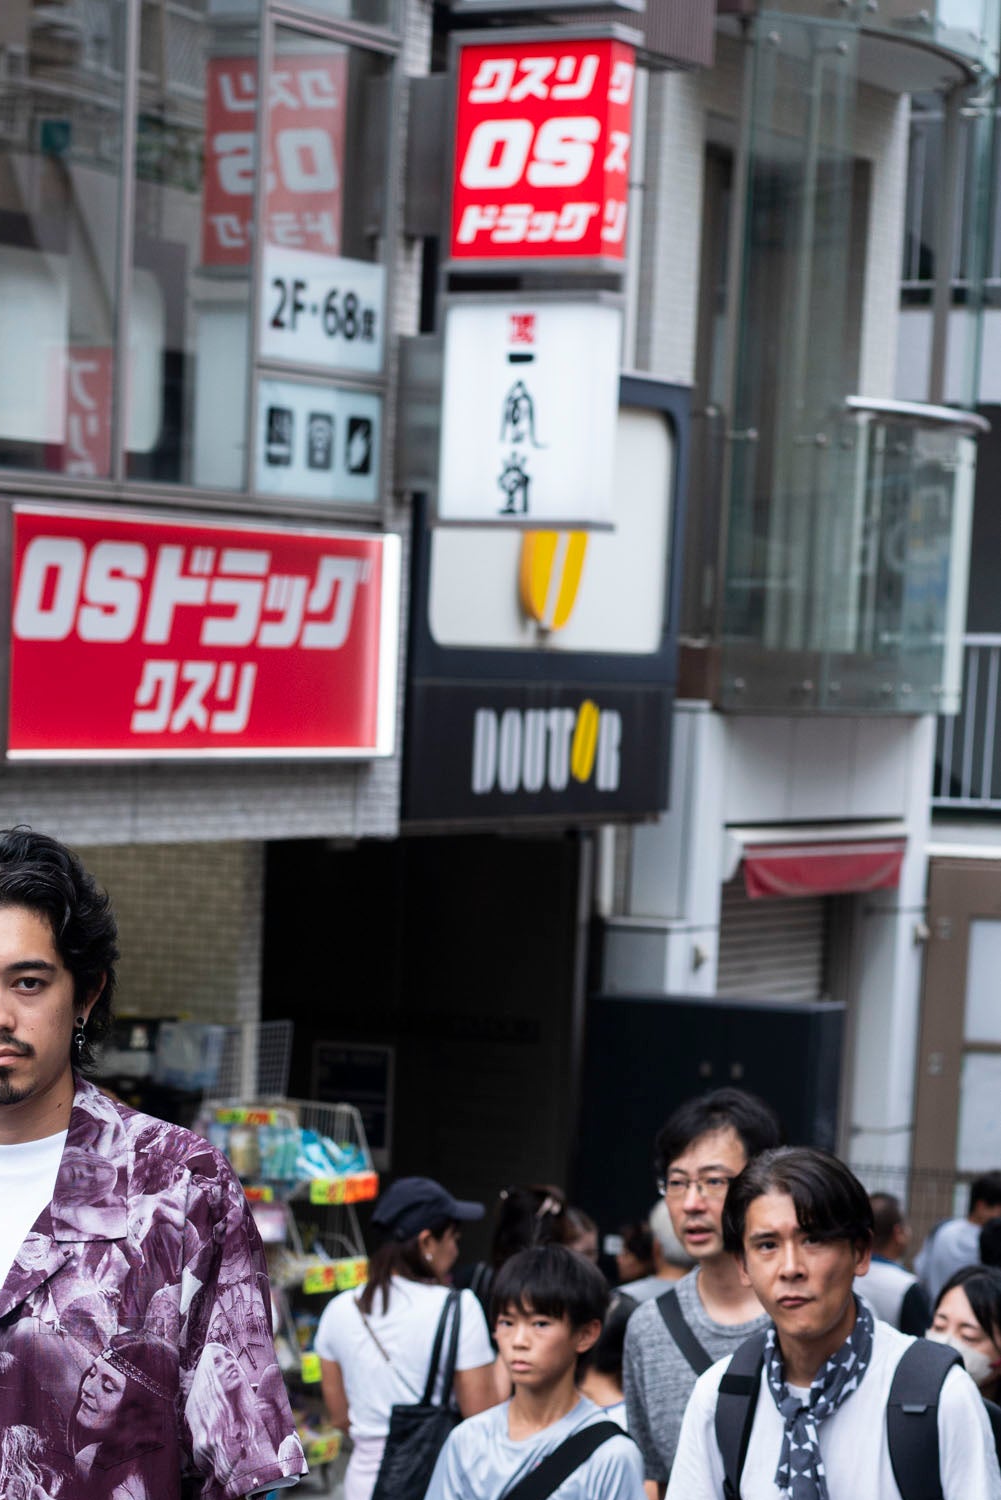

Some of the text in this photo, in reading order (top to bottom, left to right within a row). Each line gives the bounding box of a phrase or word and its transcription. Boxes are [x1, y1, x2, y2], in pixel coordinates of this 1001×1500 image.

[468, 54, 601, 104] クスリ
[459, 115, 602, 190] OS
[600, 60, 635, 244] クスリ
[456, 202, 601, 244] ドラッグ
[13, 535, 373, 651] OSドラッグ
[131, 659, 258, 734] クスリ
[471, 698, 622, 794] DOUTOR
